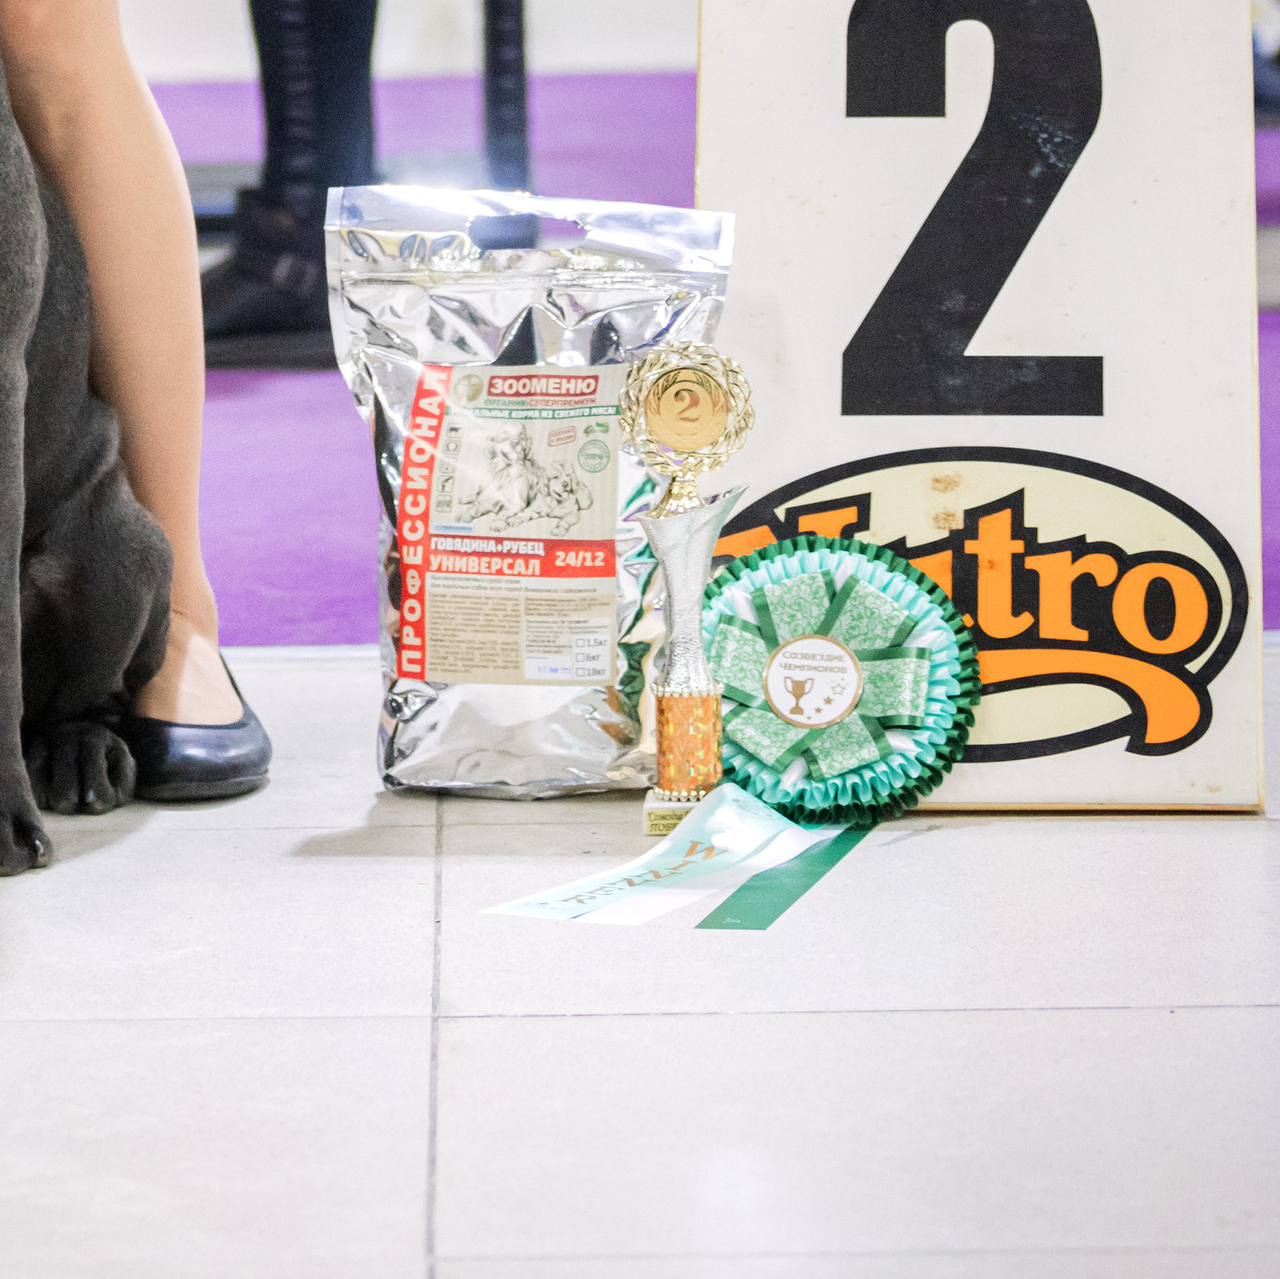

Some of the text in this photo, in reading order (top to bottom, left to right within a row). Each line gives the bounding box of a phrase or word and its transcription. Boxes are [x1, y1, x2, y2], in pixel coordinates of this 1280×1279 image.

[490, 377, 597, 395] ЗООМЕНЮ
[541, 410, 553, 419] ИЗ
[673, 388, 701, 422] 2
[401, 364, 448, 674] ПРОФЕССИОНАЛ
[429, 554, 541, 575] УНИВЕРСАЛ
[554, 551, 605, 567] 24/12
[712, 505, 1210, 655] tro
[782, 650, 846, 663] СОЗВЕЗДИЕ
[779, 662, 848, 674] ЧЕМПИОНОВ
[560, 840, 730, 905] WINNER
